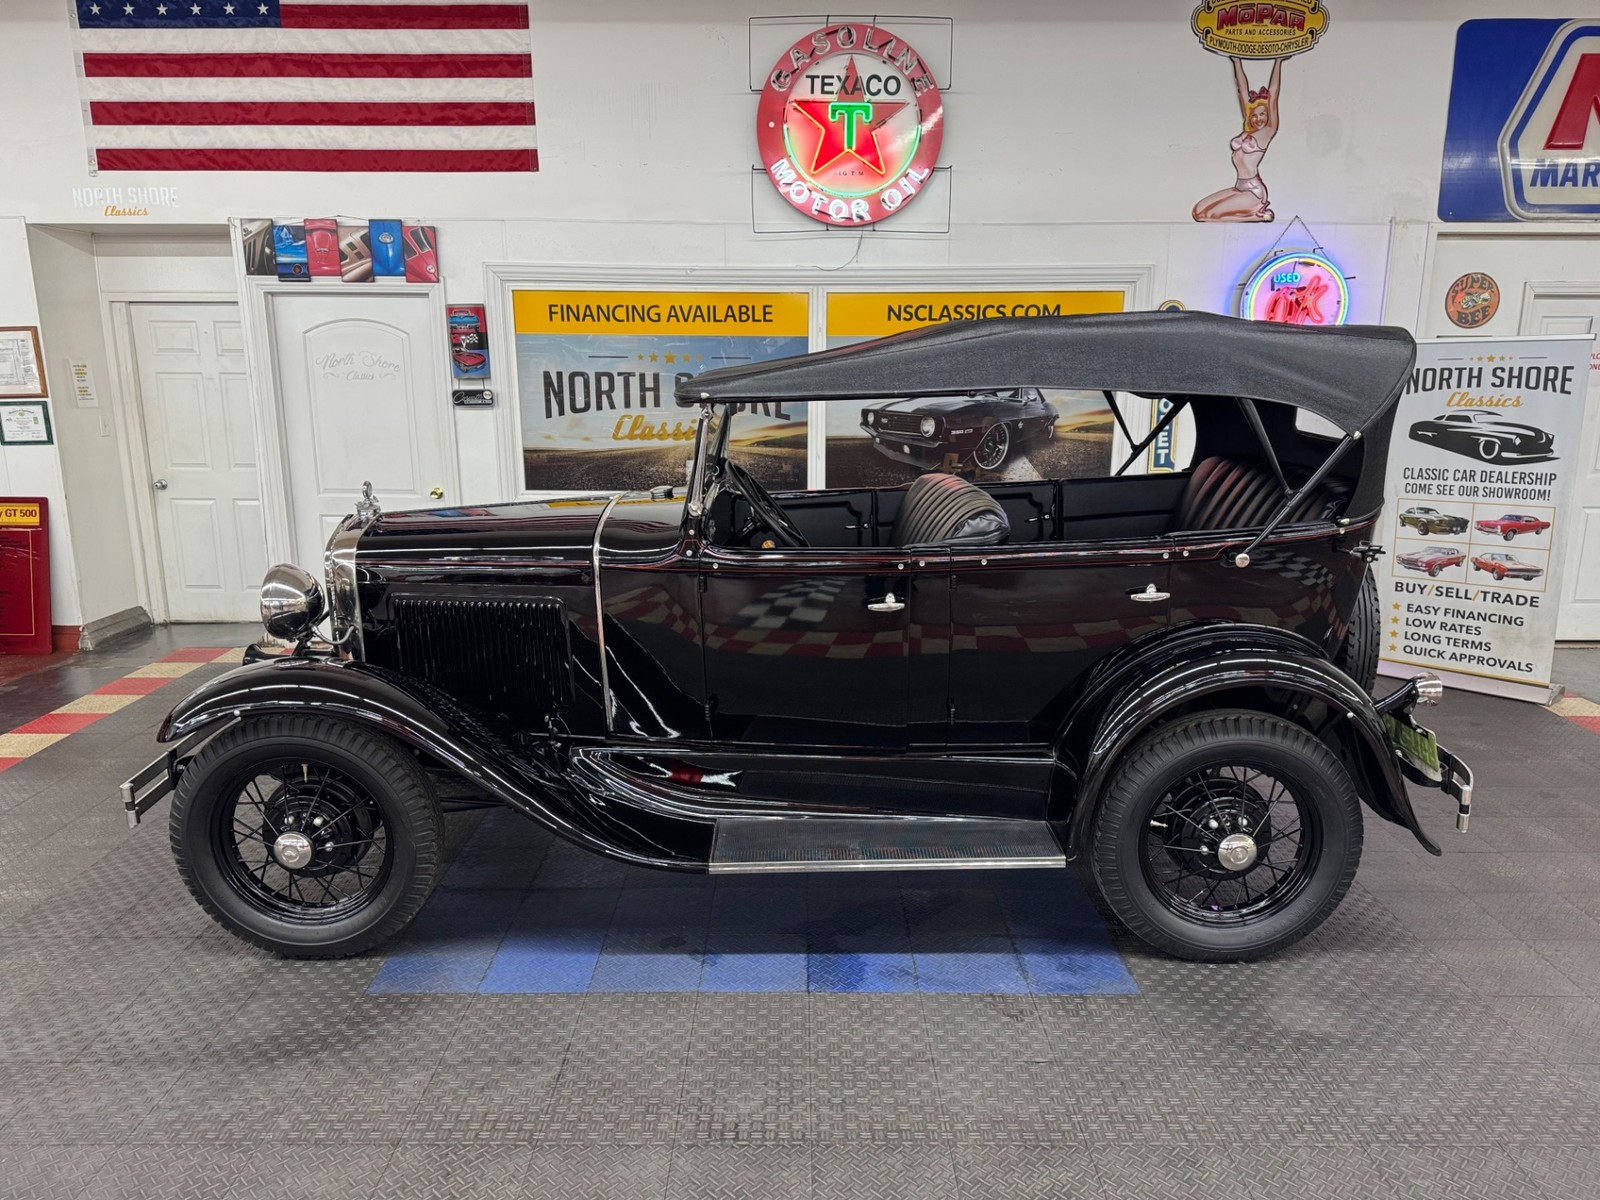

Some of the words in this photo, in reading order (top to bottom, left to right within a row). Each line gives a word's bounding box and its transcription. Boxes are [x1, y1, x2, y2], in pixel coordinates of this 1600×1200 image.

[1216, 3, 1306, 31] MOPAR
[1225, 28, 1242, 36] PARTS
[1245, 28, 1256, 36] AND
[1259, 28, 1296, 36] ACCESSORIES
[771, 25, 934, 97] GASOLINE
[806, 74, 901, 96] TEXACO
[828, 102, 872, 151] T
[72, 187, 123, 208] NORTH
[127, 187, 179, 208] SHORE
[770, 158, 872, 223] MOTOR
[881, 167, 930, 210] OIL
[104, 205, 149, 217] Classics
[1273, 272, 1301, 283] USED
[1451, 276, 1495, 305] SUPER
[548, 304, 661, 323] FINANCING
[666, 304, 774, 323] AVAILABLE
[1456, 305, 1491, 326] BEE
[1405, 366, 1484, 395] NORTH
[1490, 365, 1575, 395] SHORE
[542, 370, 661, 419] NORTH
[1446, 391, 1524, 408] Classics
[612, 414, 698, 441] Classi
[1403, 467, 1450, 482] CLASSIC
[1452, 469, 1477, 483] CAR
[1480, 470, 1558, 486] DEALERSHIP
[1404, 482, 1434, 495] COME
[1436, 484, 1455, 496] SEE
[1458, 485, 1479, 498] OUR
[1481, 487, 1552, 501] SHOWROOM!
[5, 509, 18, 518] GT
[20, 509, 37, 518] 500
[1406, 603, 1441, 616] EASY
[1443, 608, 1525, 627] FINANCING
[1405, 617, 1436, 630] LOW
[1439, 622, 1483, 636] RATES
[1404, 631, 1442, 645] LONG
[1445, 637, 1492, 652] TERMS
[1402, 645, 1446, 660] QUICK
[1448, 652, 1534, 673] APPROVALS
